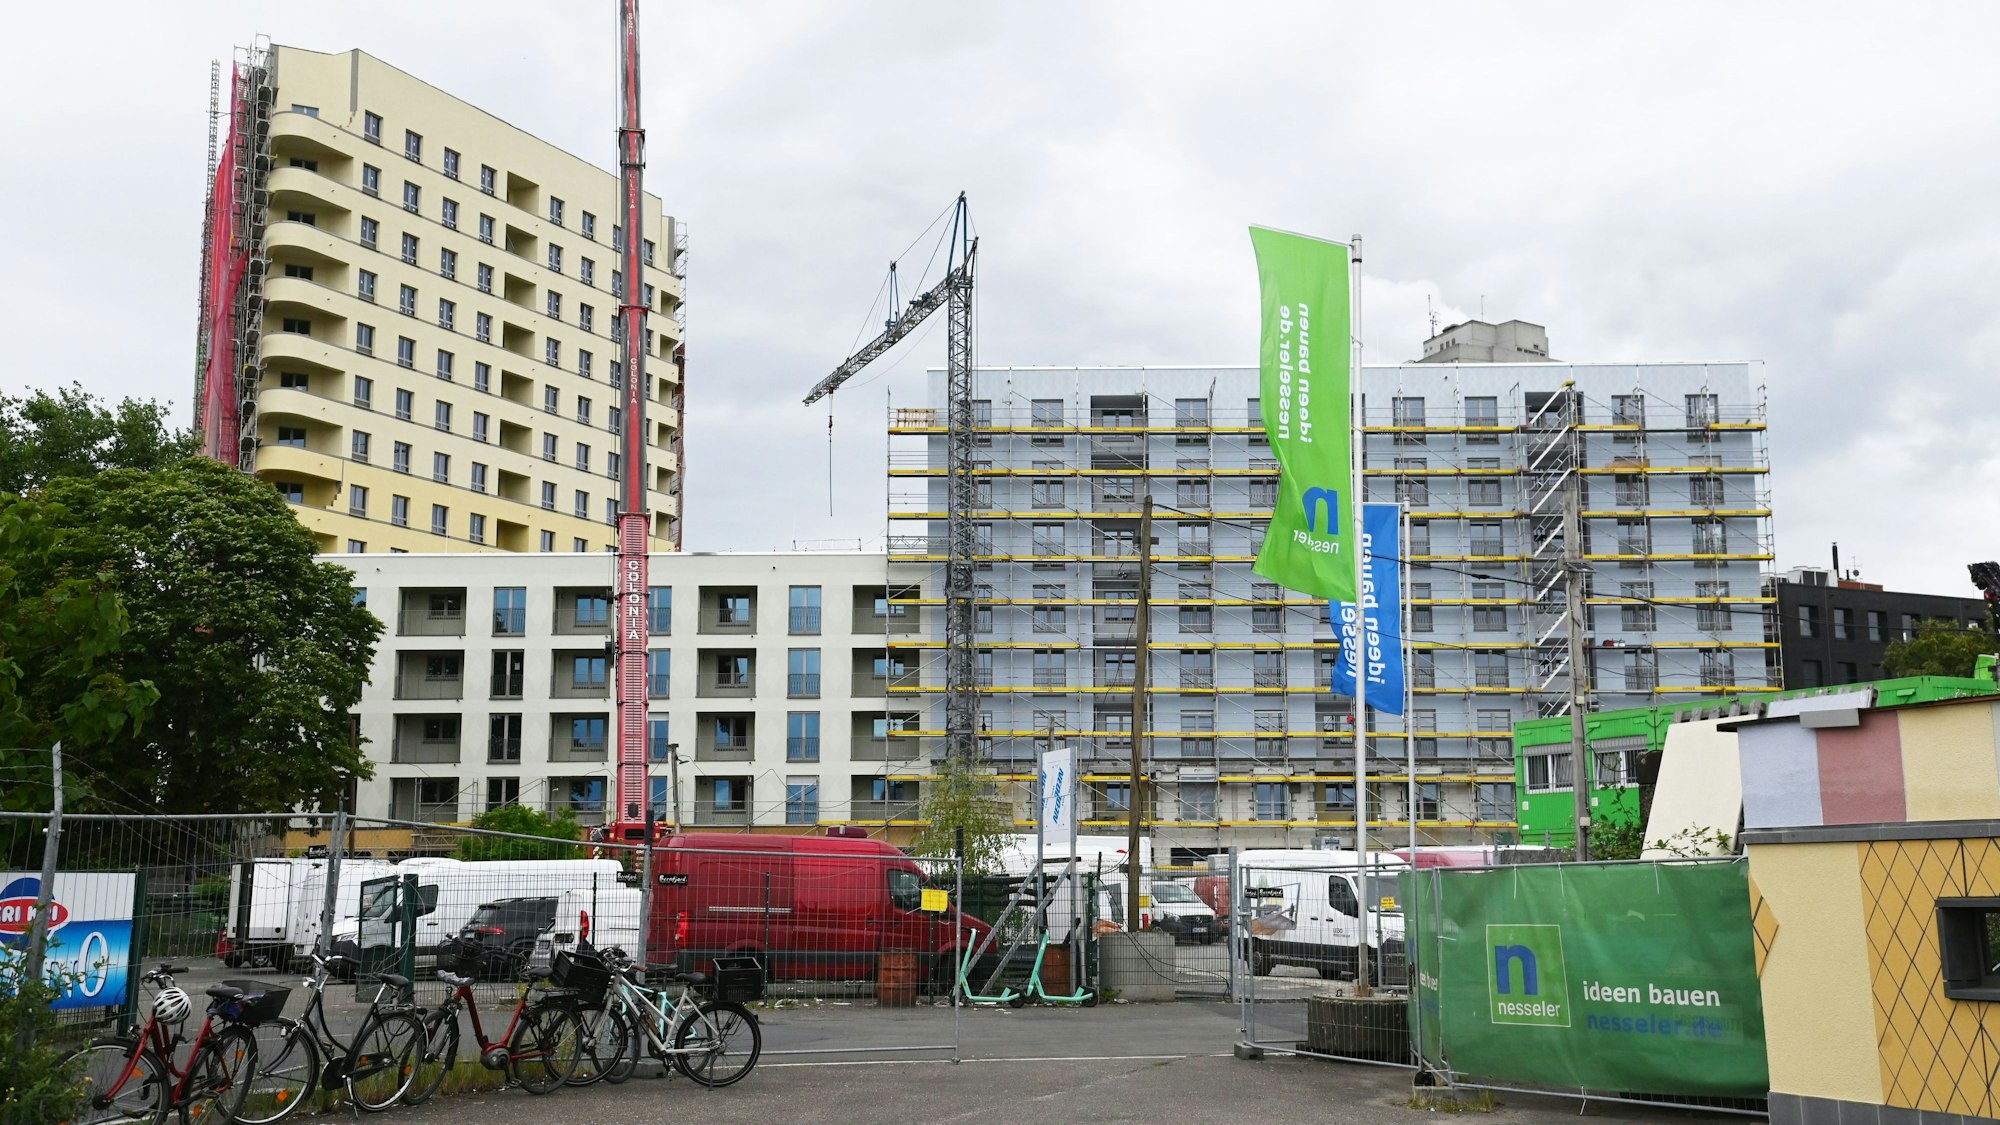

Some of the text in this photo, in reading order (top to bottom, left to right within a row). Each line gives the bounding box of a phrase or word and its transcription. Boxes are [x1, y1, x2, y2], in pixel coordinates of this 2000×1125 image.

[630, 357, 638, 404] COLONIA
[627, 560, 640, 640] COLONIA
[0, 905, 58, 922] RI KI
[1495, 945, 1538, 995] n
[1583, 981, 1721, 1007] ideen bauen
[1498, 1000, 1561, 1017] nesseler
[1586, 1012, 1722, 1038] nesseler.de
